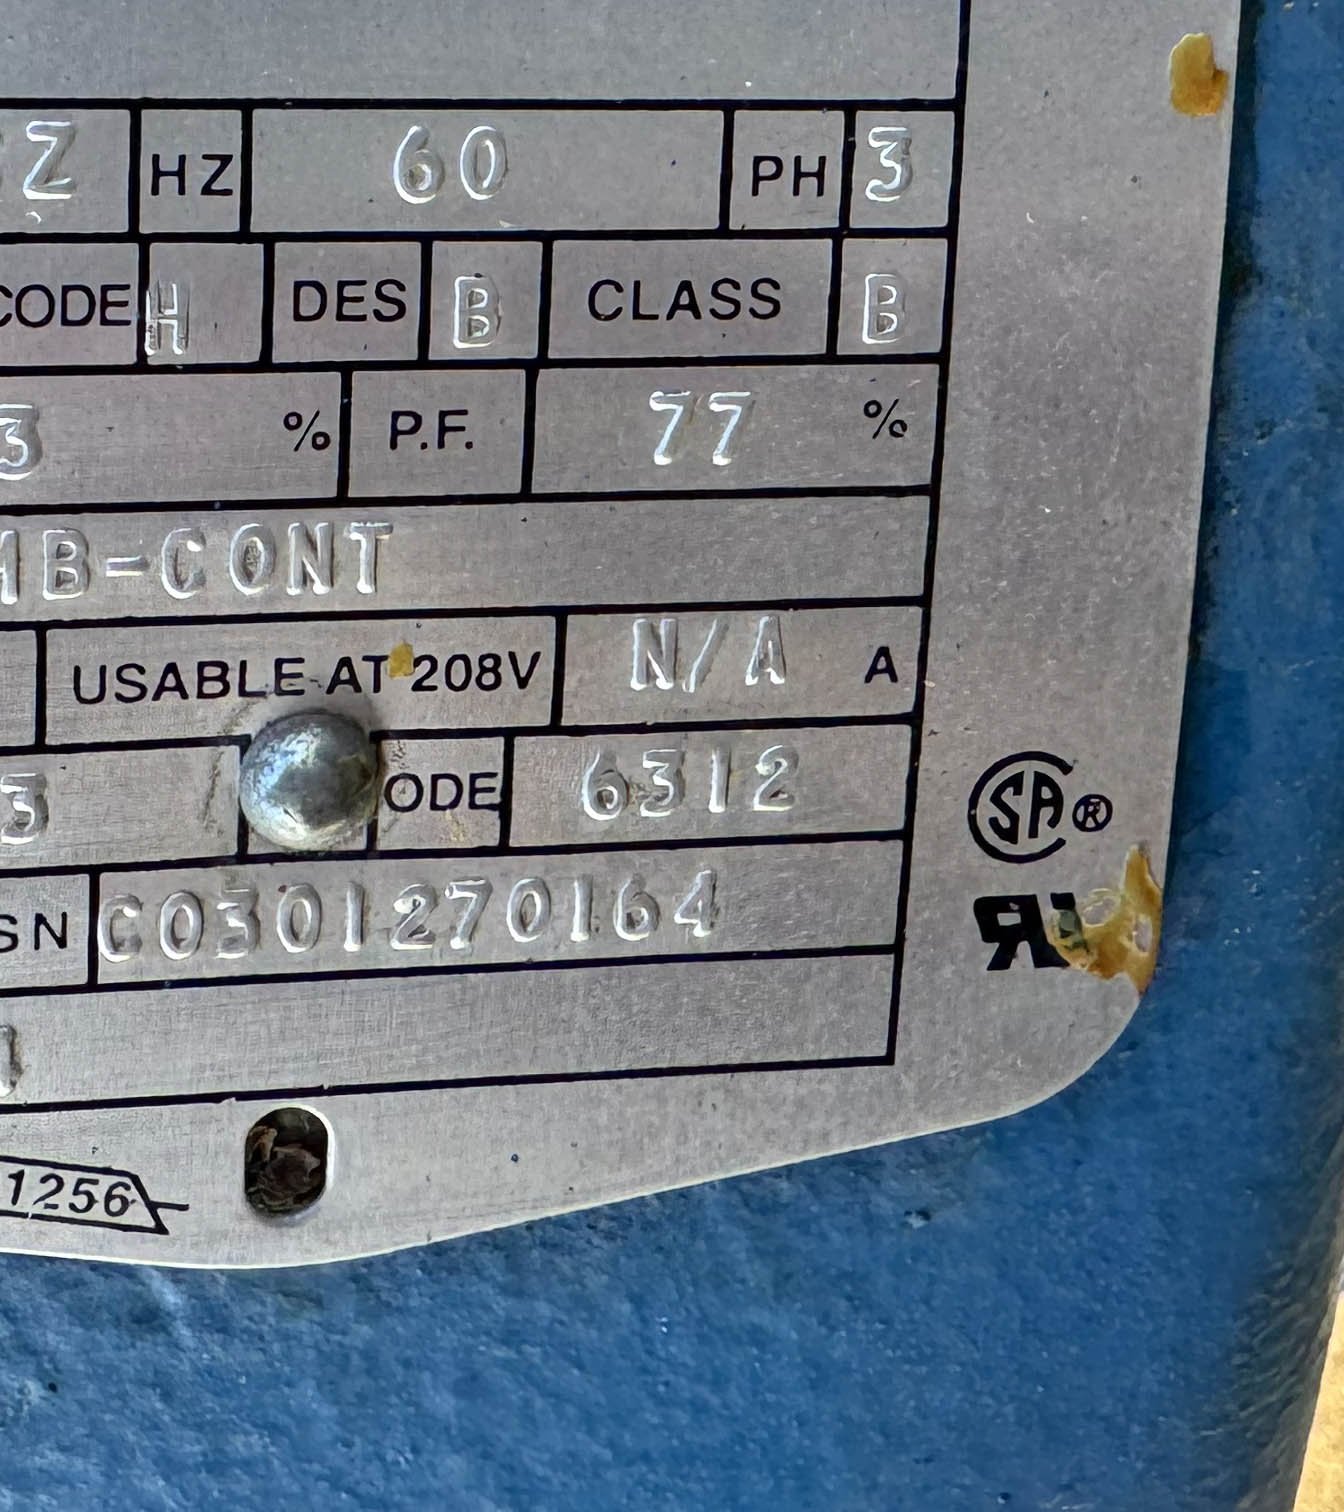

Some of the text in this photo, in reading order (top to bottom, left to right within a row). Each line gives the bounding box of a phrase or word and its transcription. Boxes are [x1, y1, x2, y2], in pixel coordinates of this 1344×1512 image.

[150, 154, 235, 196] HZ
[392, 124, 509, 205] 60
[751, 154, 827, 198] PH
[863, 125, 914, 202] 3
[293, 281, 407, 323] DES
[453, 274, 502, 349] B
[587, 279, 782, 321] CLASS
[862, 273, 900, 345] B
[283, 411, 331, 451] %
[389, 411, 474, 451] P.F.
[648, 390, 757, 466] 77
[862, 399, 908, 439] %
[72, 656, 306, 707] USABLE
[326, 654, 390, 695] AT
[410, 650, 542, 694] 208V
[628, 615, 786, 694] N/A
[864, 646, 898, 684] A
[383, 771, 500, 813] ODE
[580, 744, 801, 822] 6312
